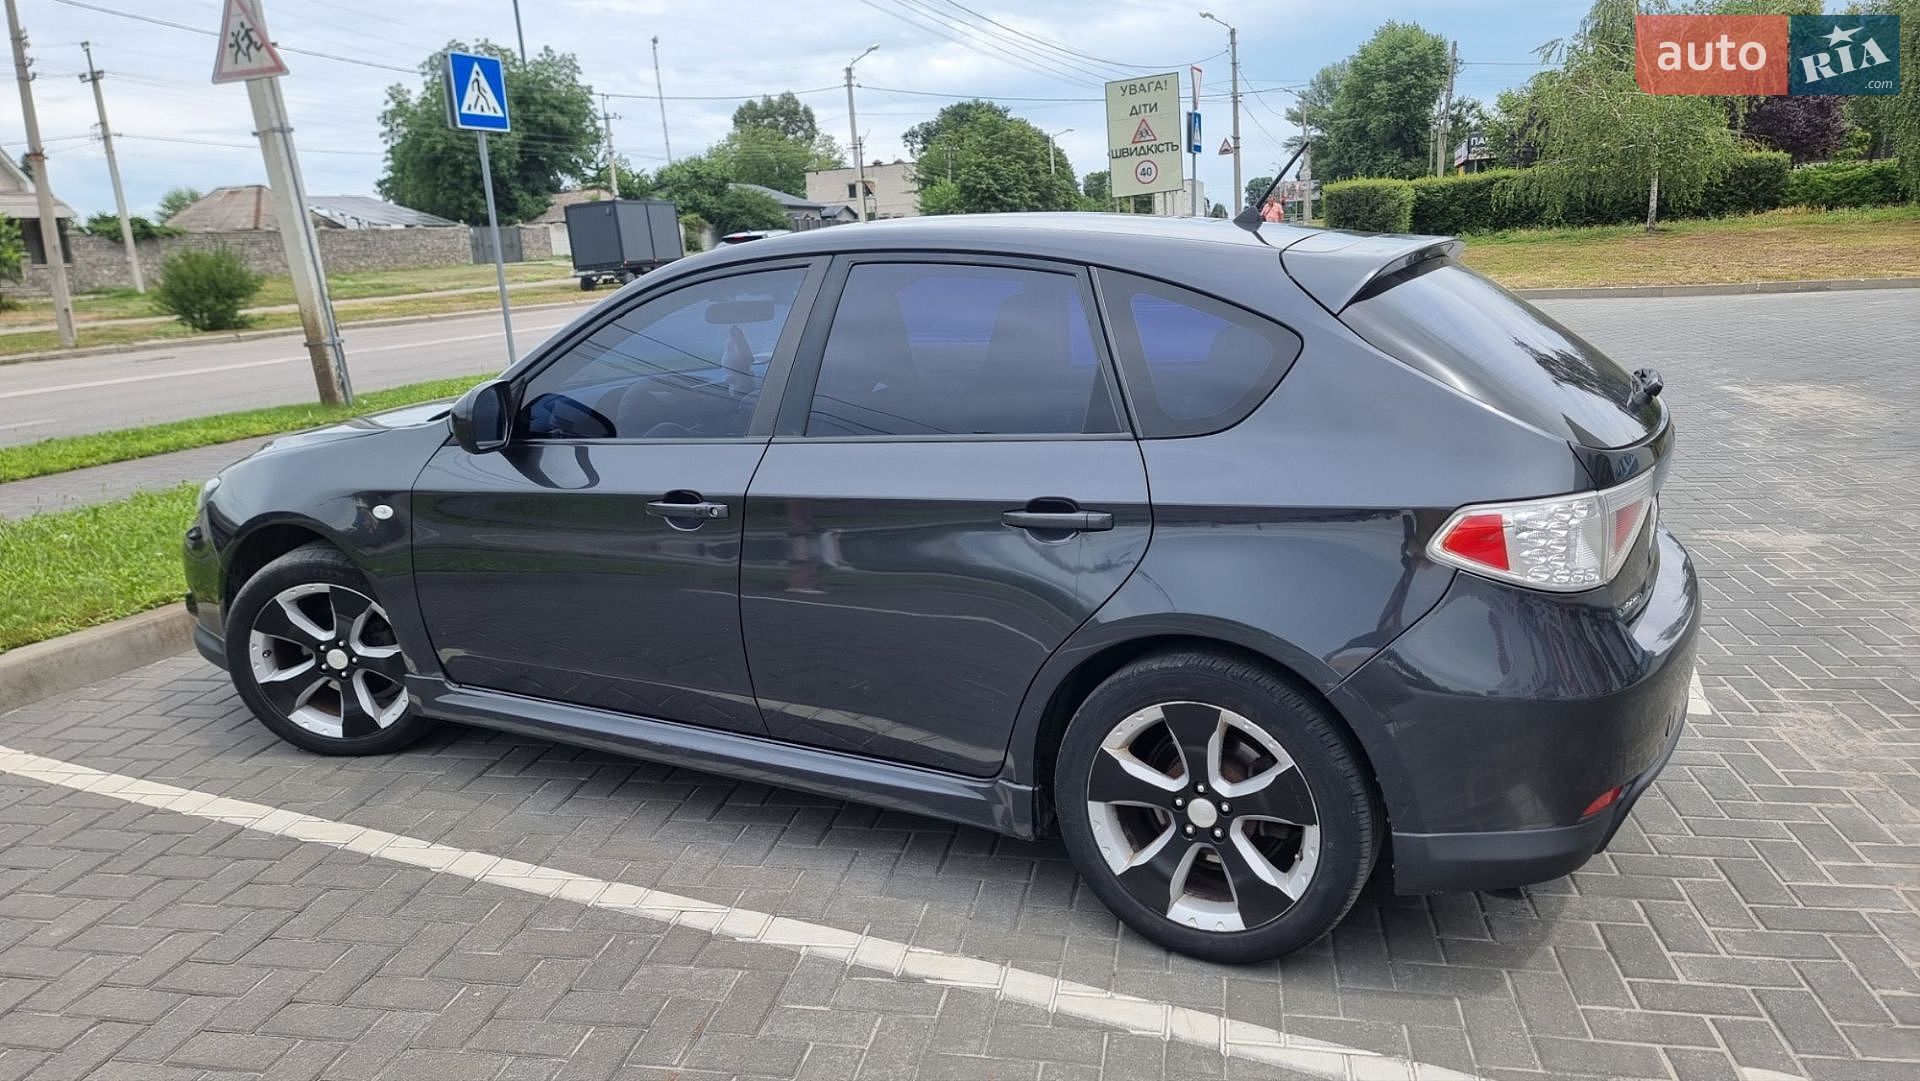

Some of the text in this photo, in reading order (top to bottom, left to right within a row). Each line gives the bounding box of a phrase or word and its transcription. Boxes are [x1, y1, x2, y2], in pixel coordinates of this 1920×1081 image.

[1120, 79, 1168, 96] УВАГА!
[1129, 102, 1158, 116] ДІТИ
[1111, 141, 1179, 159] ШВИДКІСТЬ
[1140, 167, 1152, 177] 40
